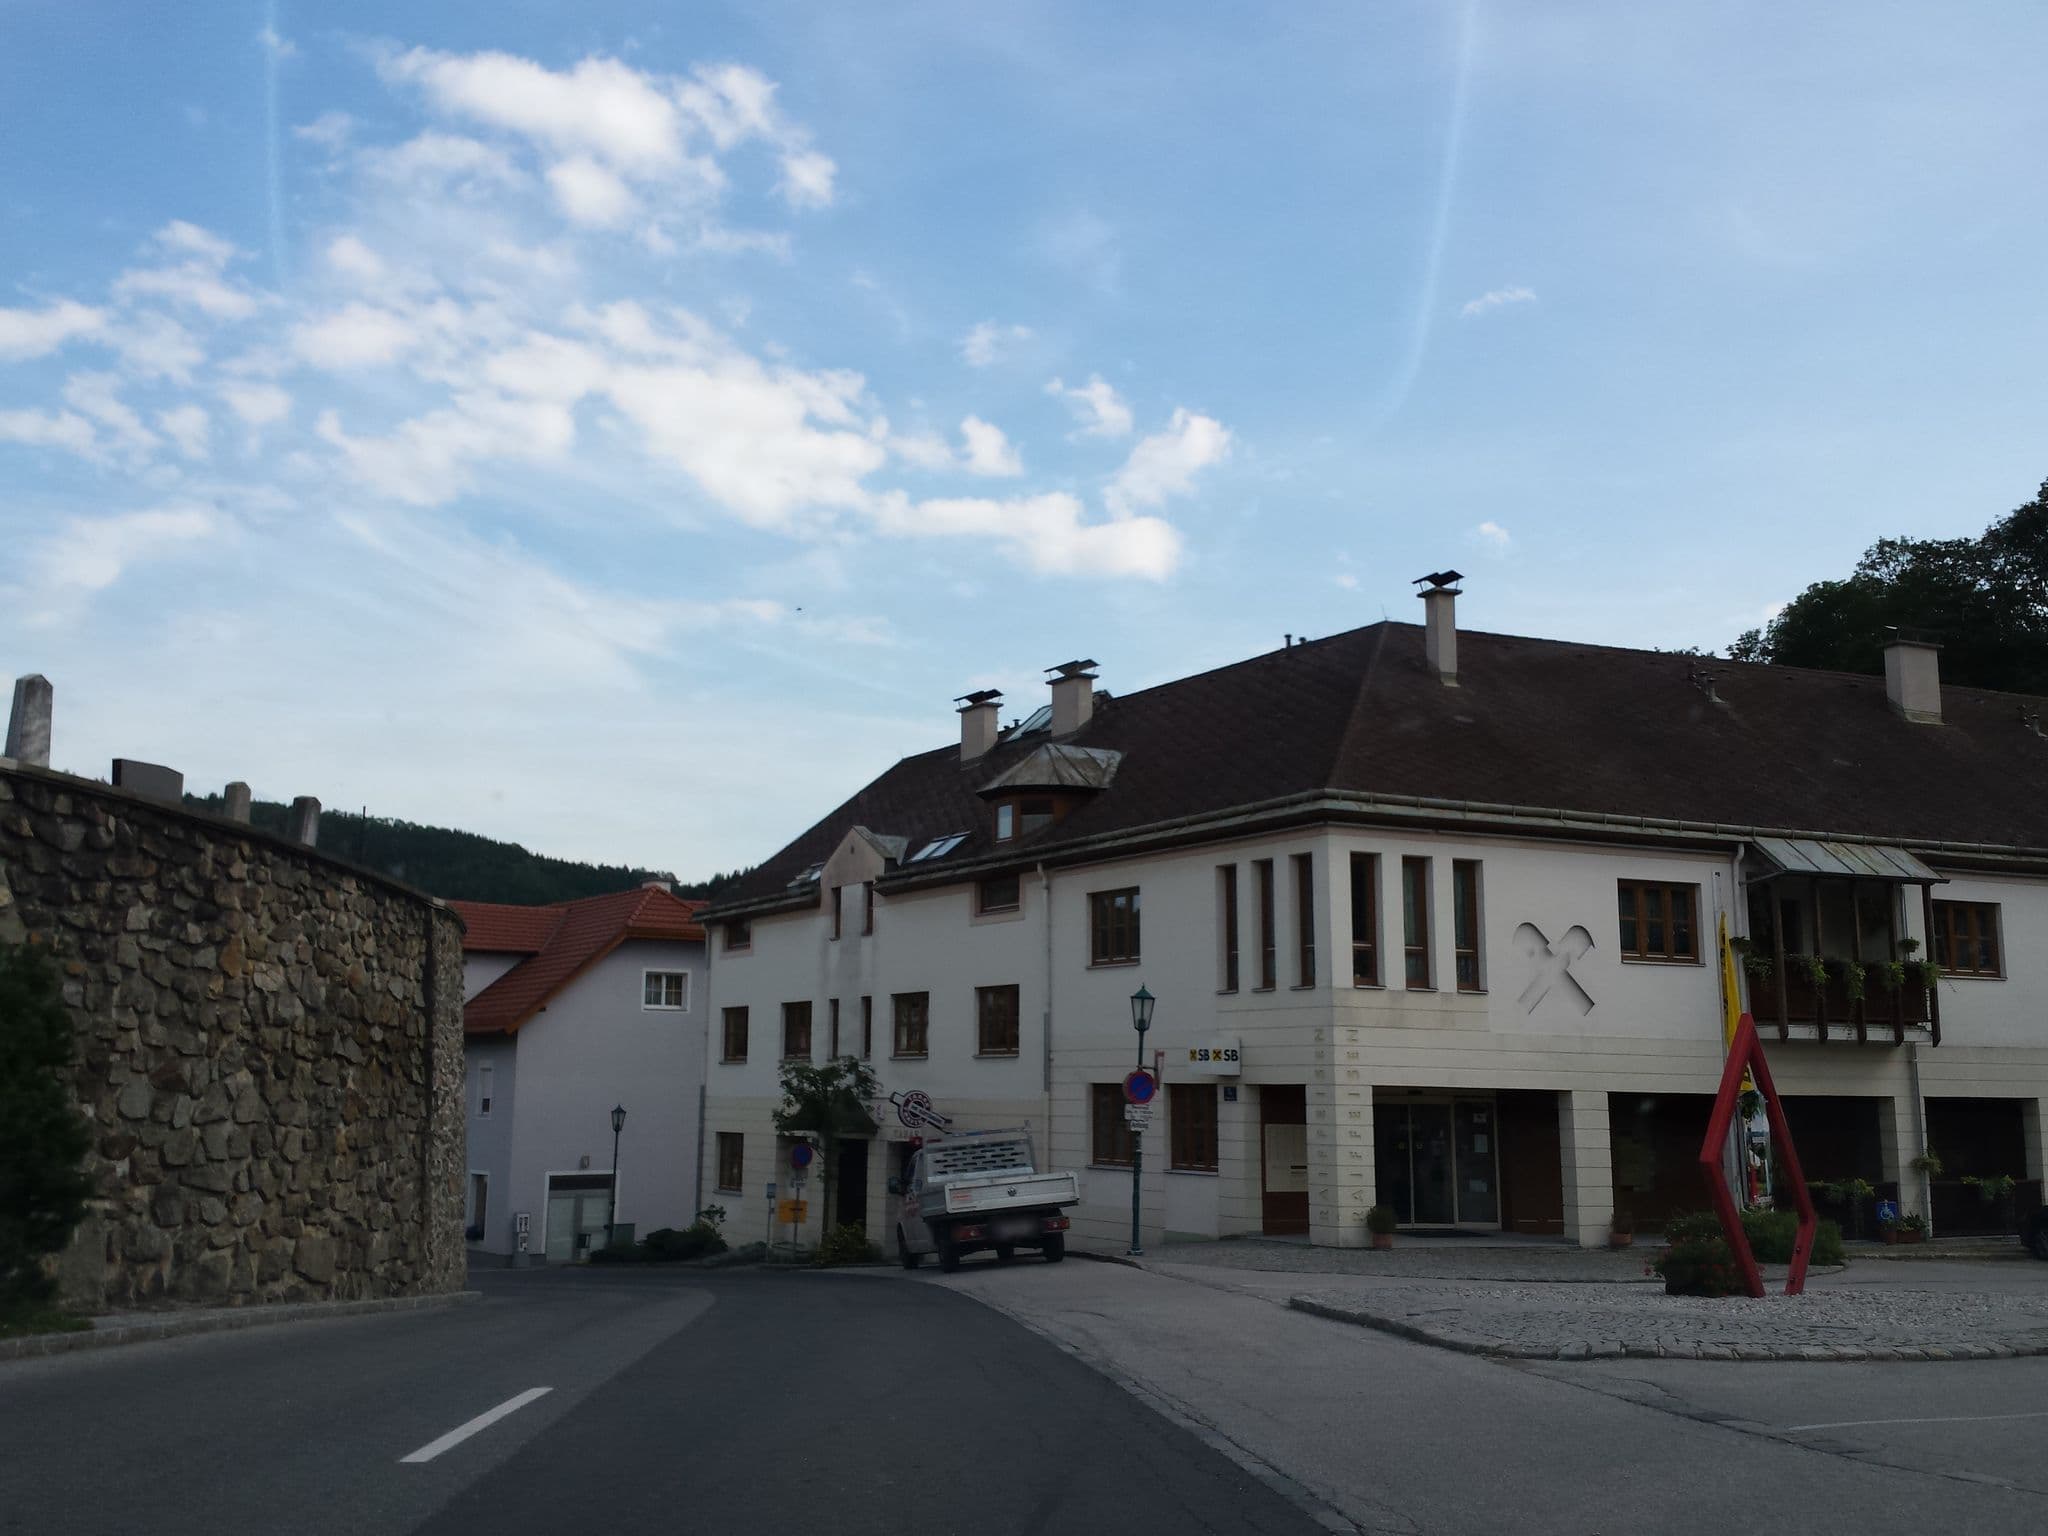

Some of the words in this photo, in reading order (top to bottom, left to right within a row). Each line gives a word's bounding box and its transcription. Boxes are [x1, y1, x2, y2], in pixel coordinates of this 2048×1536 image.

[1198, 1048, 1210, 1061] SB
[1223, 1048, 1239, 1062] SB
[1345, 1029, 1364, 1222] RAIFFEISEN
